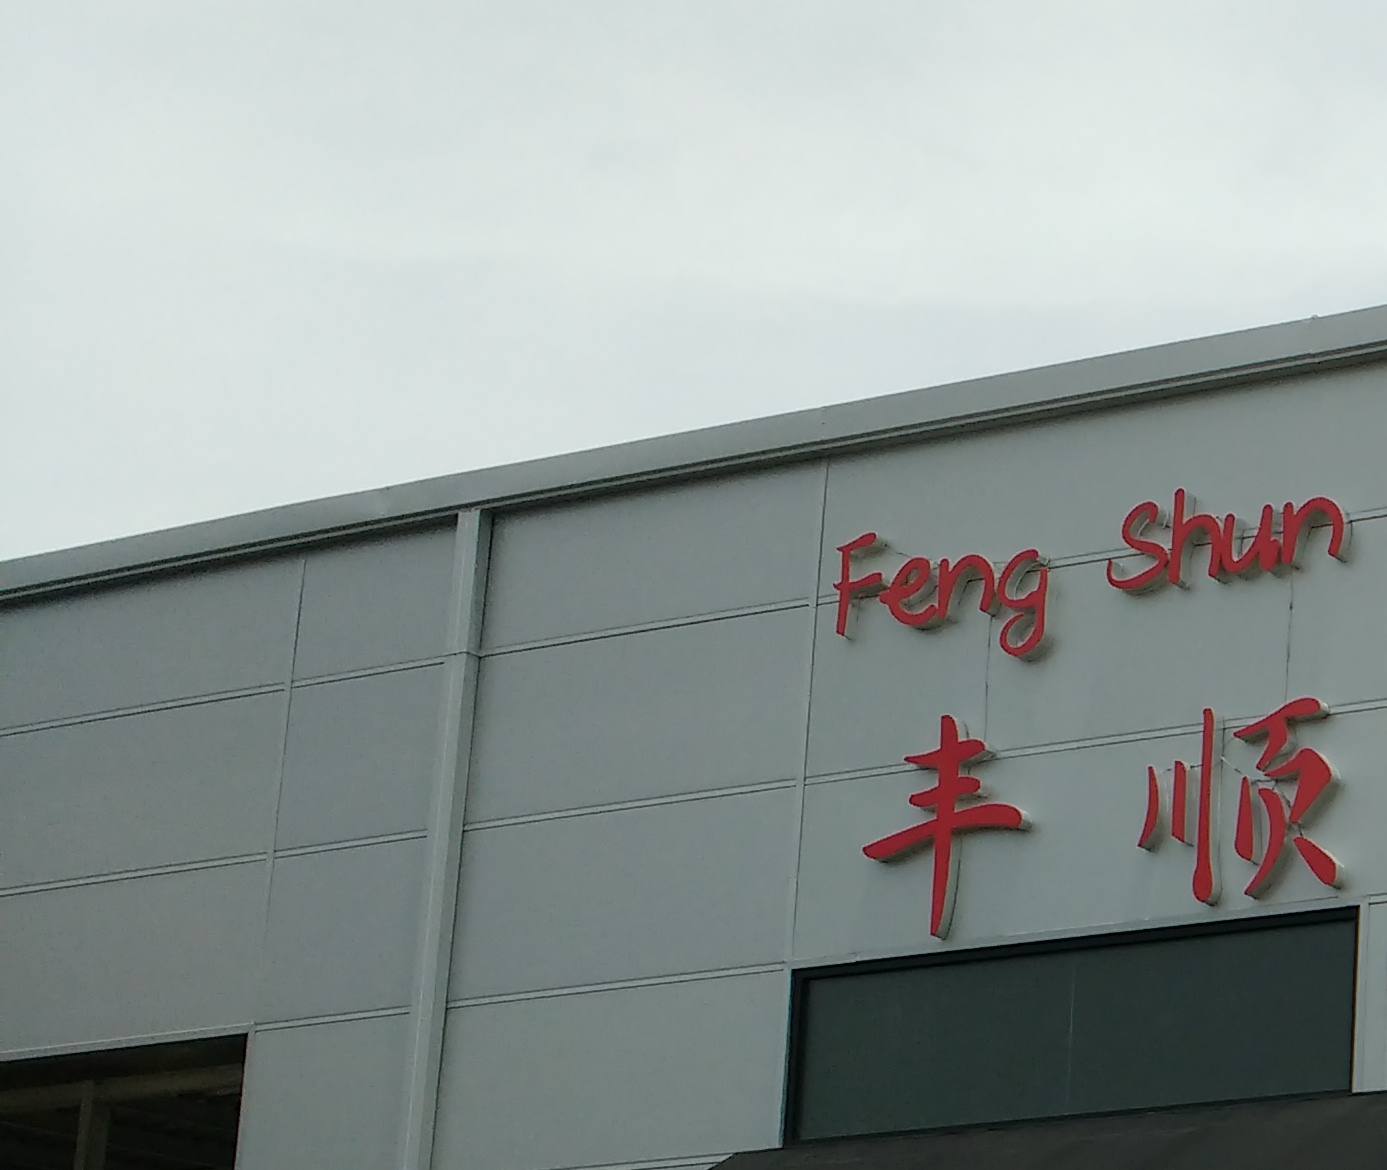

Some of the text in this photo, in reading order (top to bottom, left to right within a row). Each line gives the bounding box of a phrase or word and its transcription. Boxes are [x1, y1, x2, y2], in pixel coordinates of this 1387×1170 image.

[832, 487, 1348, 658] Feng Shun
[862, 697, 1339, 936] 丰 顺
